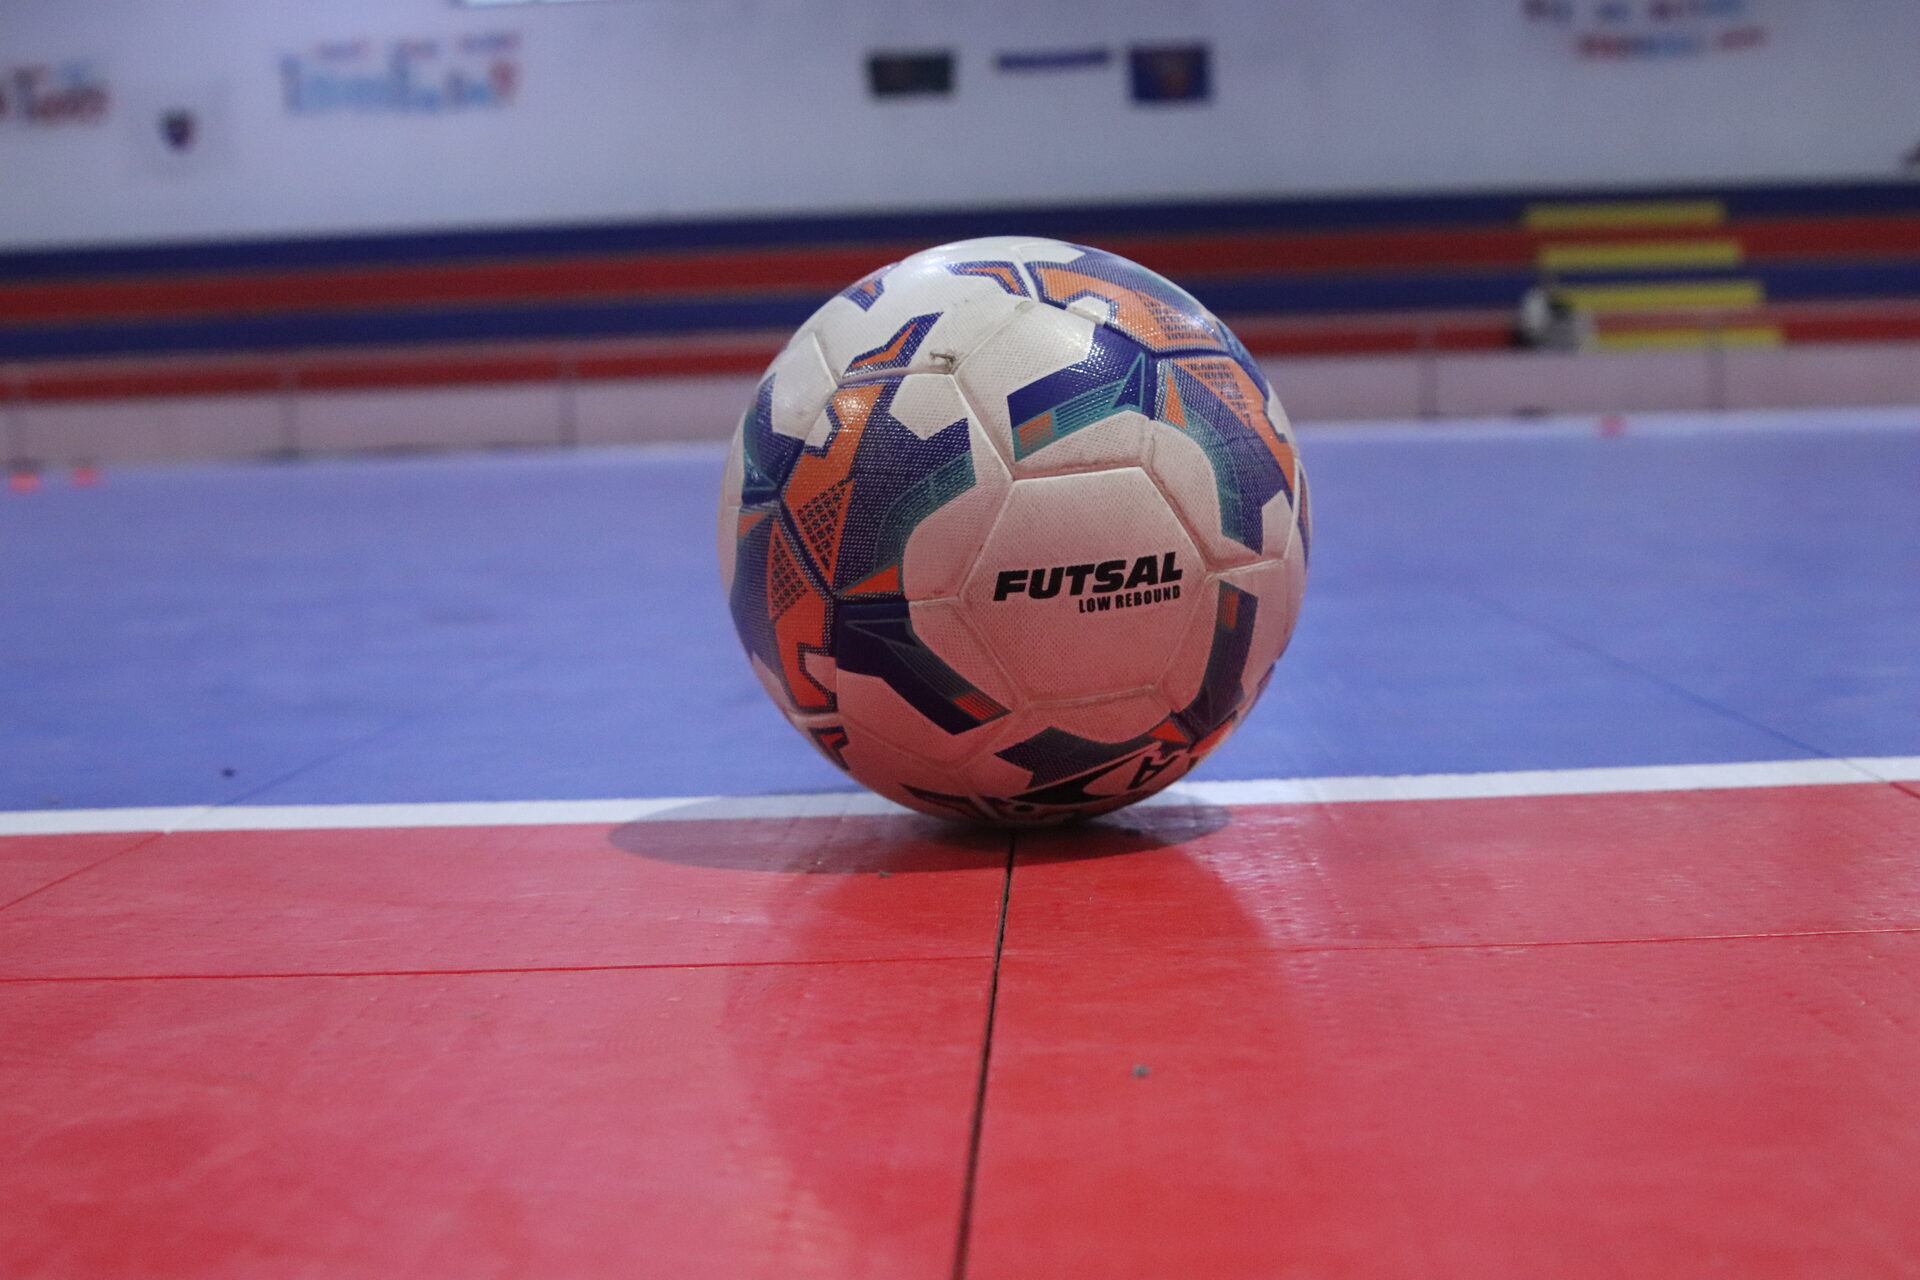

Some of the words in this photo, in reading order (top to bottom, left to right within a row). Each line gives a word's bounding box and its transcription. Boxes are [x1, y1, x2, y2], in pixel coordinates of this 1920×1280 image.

[993, 552, 1183, 601] FUTSAL
[1079, 597, 1111, 613] LOW
[1115, 585, 1181, 609] REBOUND
